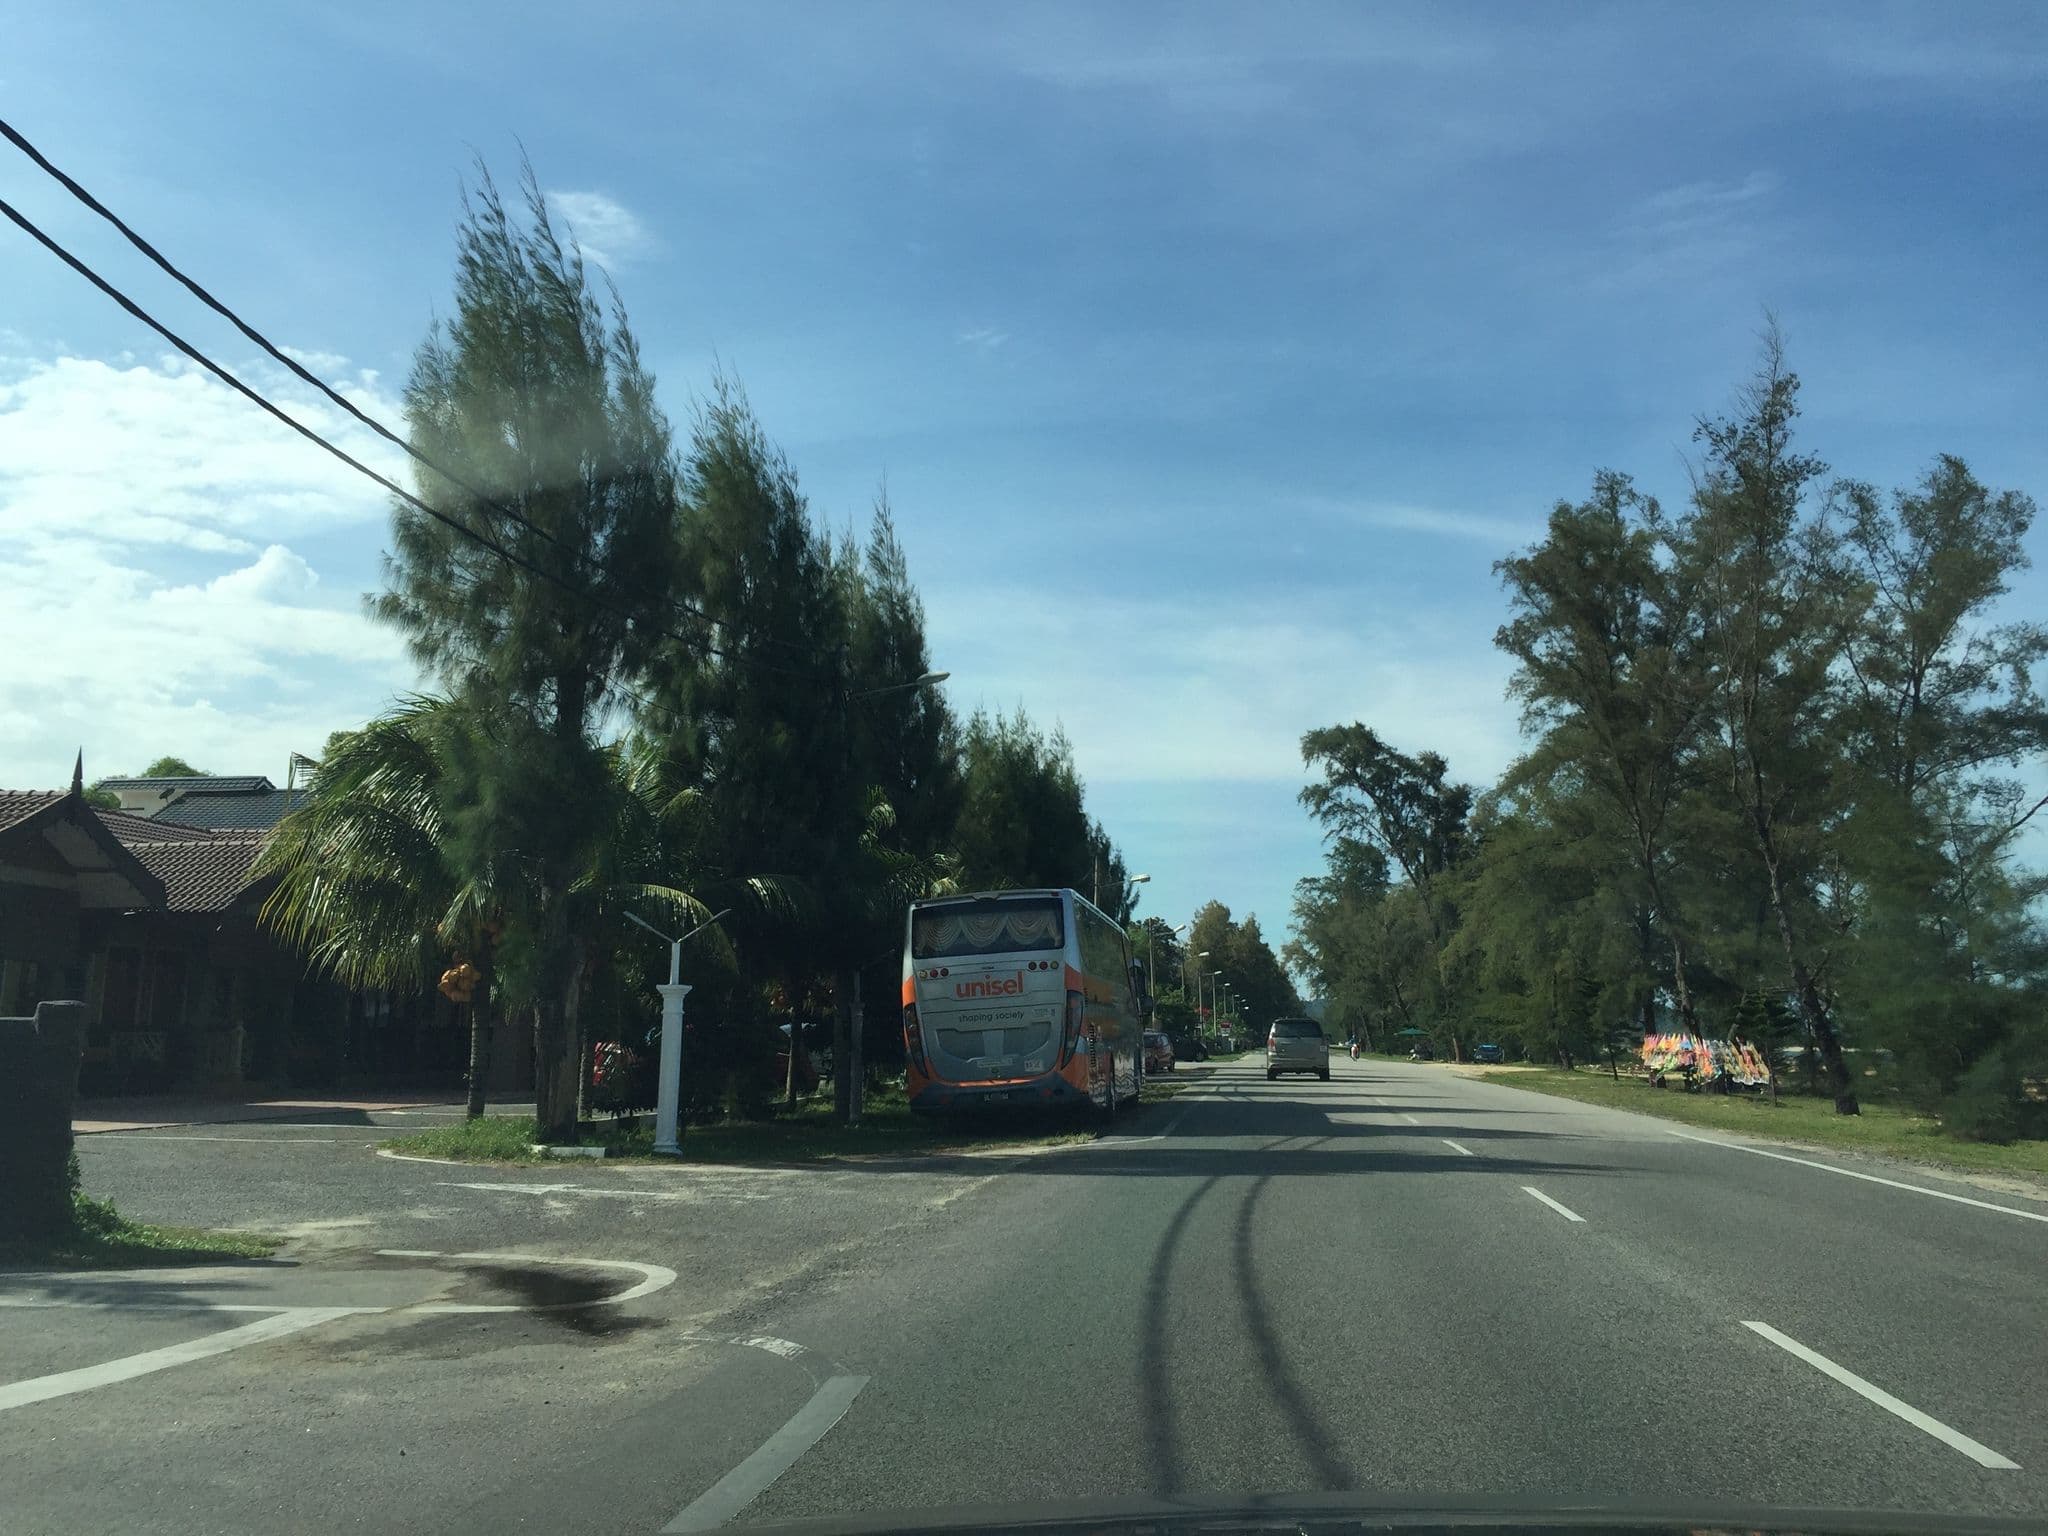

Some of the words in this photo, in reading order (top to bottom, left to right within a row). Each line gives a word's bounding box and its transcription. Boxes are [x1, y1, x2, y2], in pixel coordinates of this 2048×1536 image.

[956, 971, 1023, 997] unisel
[959, 1013, 993, 1023] shaping
[995, 1010, 1024, 1020] society
